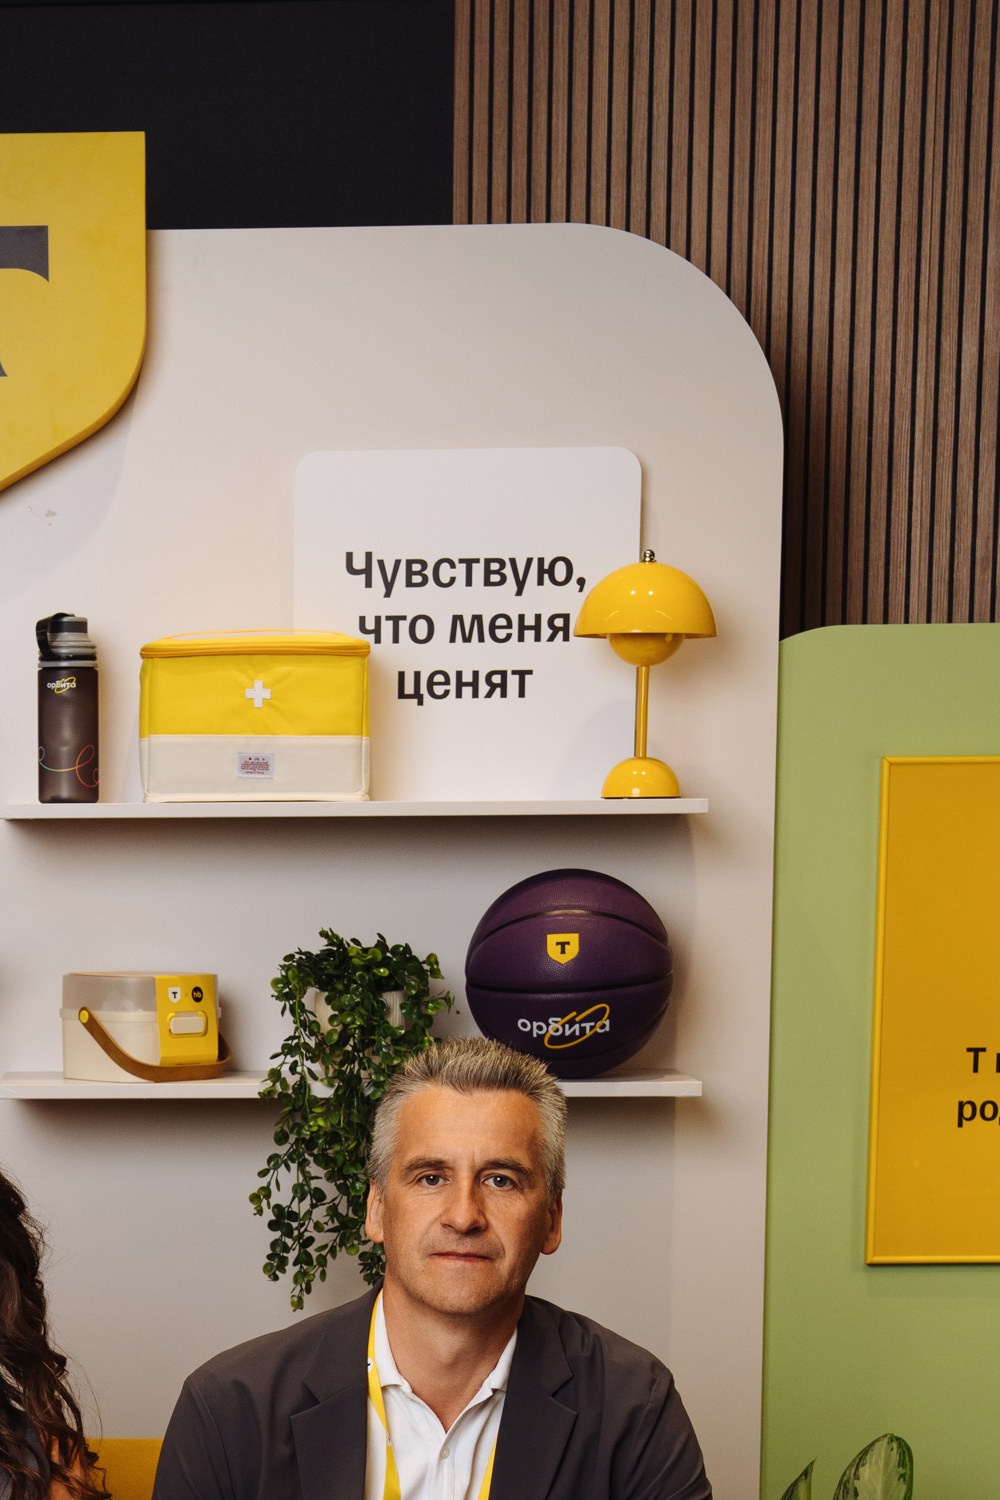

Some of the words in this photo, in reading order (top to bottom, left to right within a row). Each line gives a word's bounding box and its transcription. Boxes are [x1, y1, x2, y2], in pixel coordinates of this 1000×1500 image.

[345, 551, 586, 598] Чувствую,
[358, 614, 435, 644] что
[449, 612, 571, 643] меня
[47, 679, 77, 690] орбита
[397, 669, 533, 706] ценят
[555, 941, 571, 955] Т
[517, 1011, 610, 1038] орбита
[966, 1047, 987, 1073] Т
[957, 1100, 1000, 1128] ро
